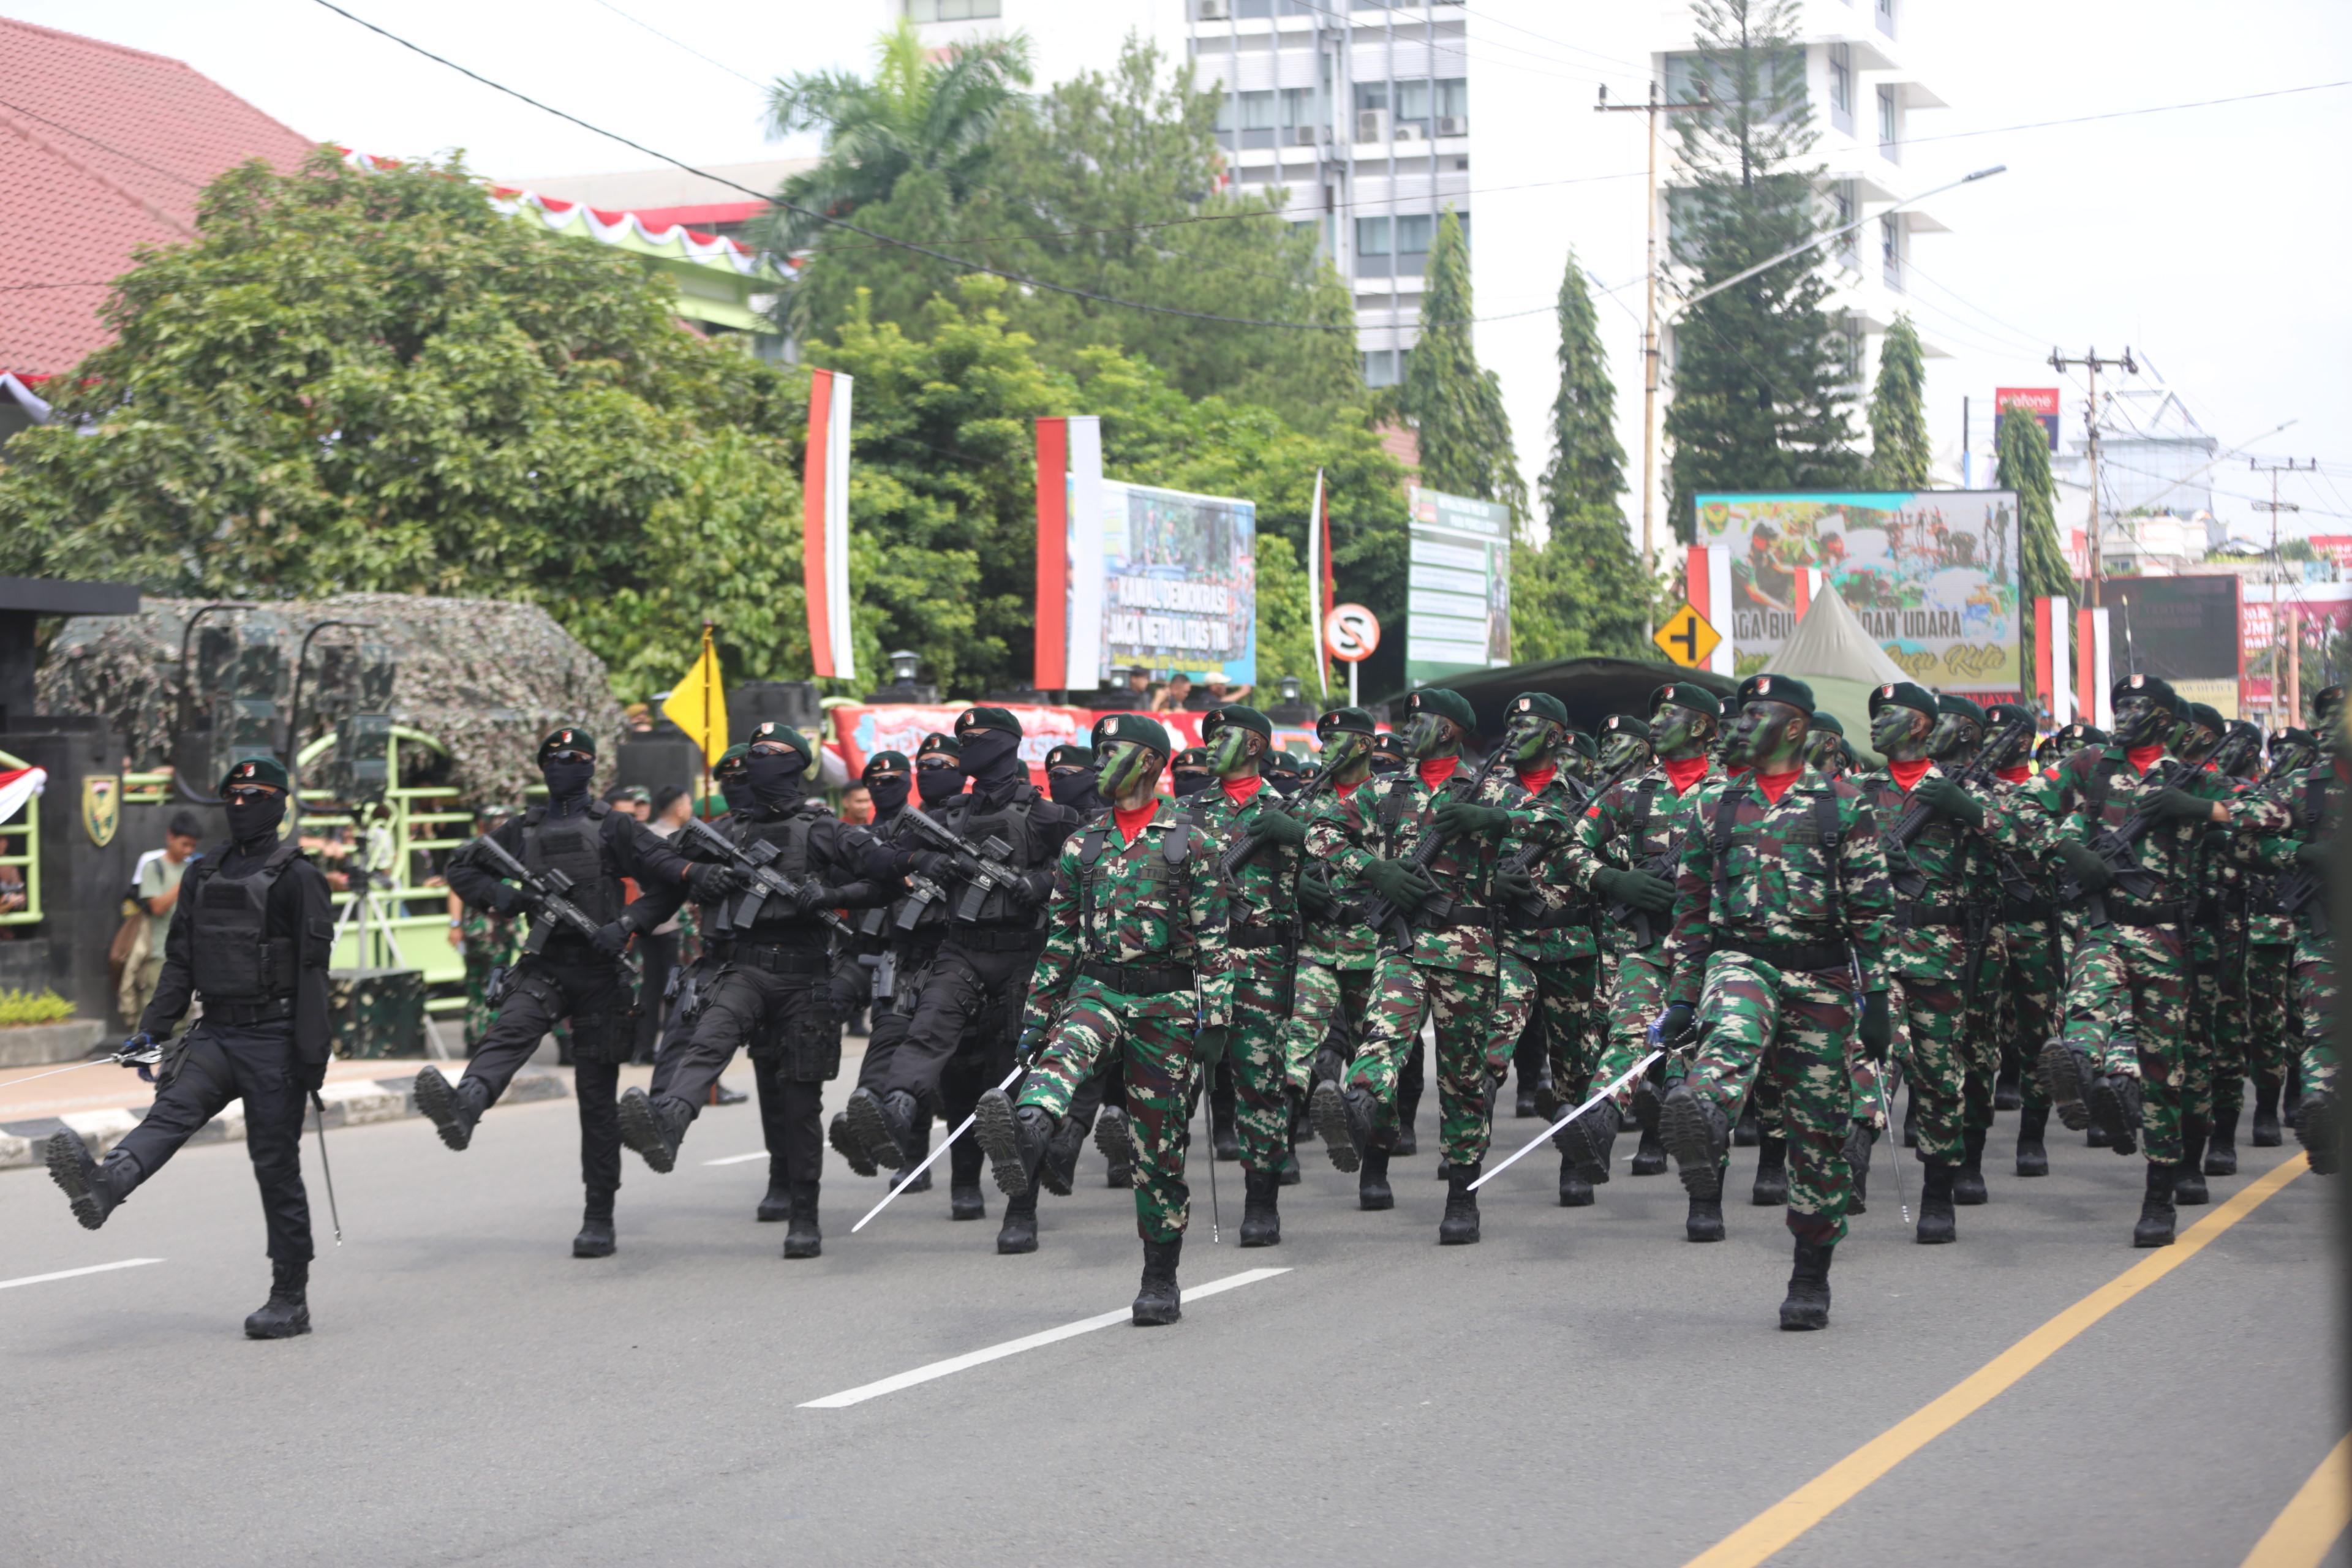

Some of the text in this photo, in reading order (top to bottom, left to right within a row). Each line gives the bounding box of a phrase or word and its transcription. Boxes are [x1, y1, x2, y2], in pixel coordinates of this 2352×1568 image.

[1999, 393, 2052, 408] eafone
[1119, 575, 1161, 609] KAWAL
[1108, 614, 1140, 645] JAGA
[1141, 616, 1209, 650] NETRALITAS
[1340, 616, 1364, 649] S
[1904, 611, 1963, 638] UDARA
[1944, 643, 2007, 678] Kita
